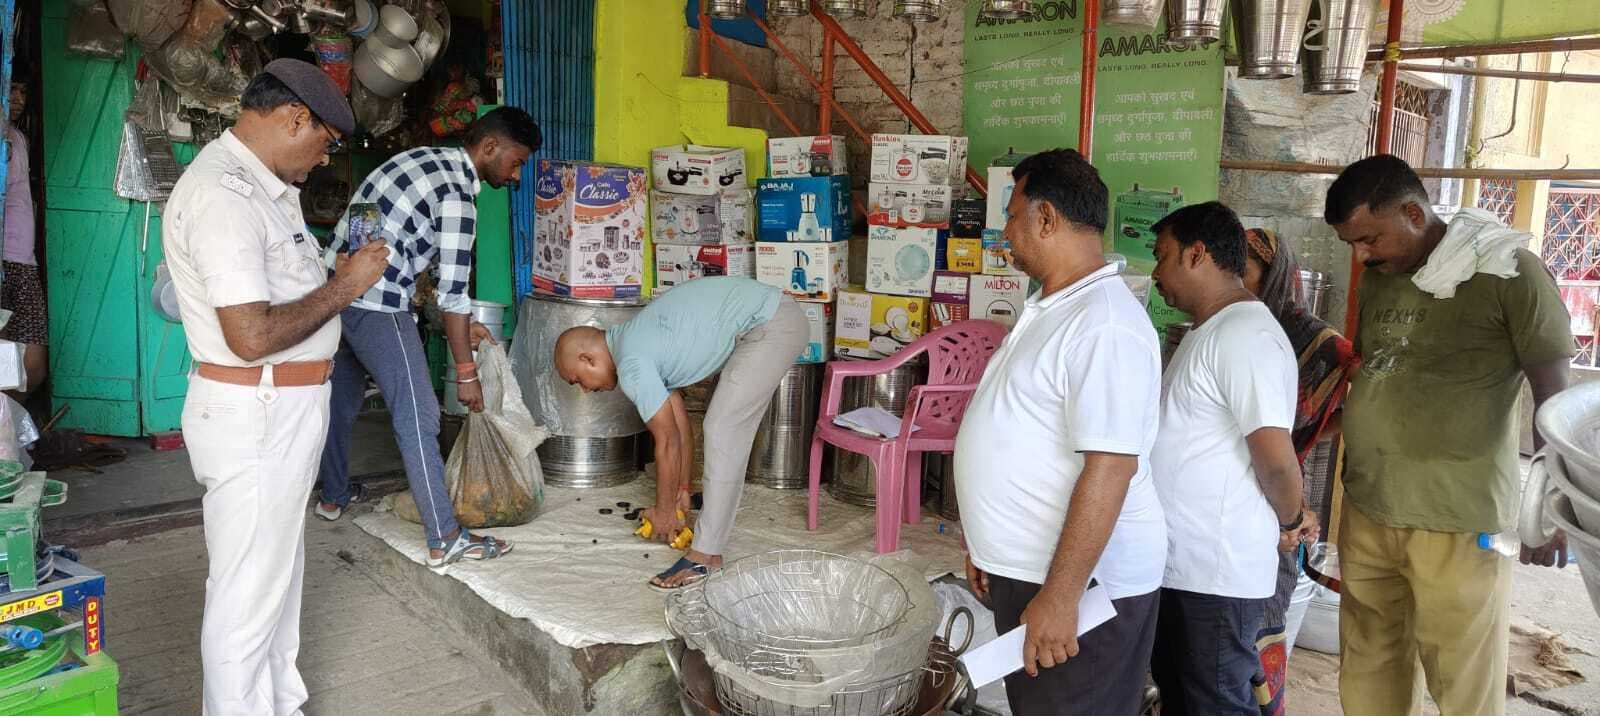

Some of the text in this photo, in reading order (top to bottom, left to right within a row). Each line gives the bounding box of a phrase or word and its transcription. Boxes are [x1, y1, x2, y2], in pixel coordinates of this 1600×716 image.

[579, 184, 620, 201] Classic
[767, 182, 794, 191] BAJAJ
[984, 279, 1020, 290] MILTON
[87, 601, 99, 651] DUTY
